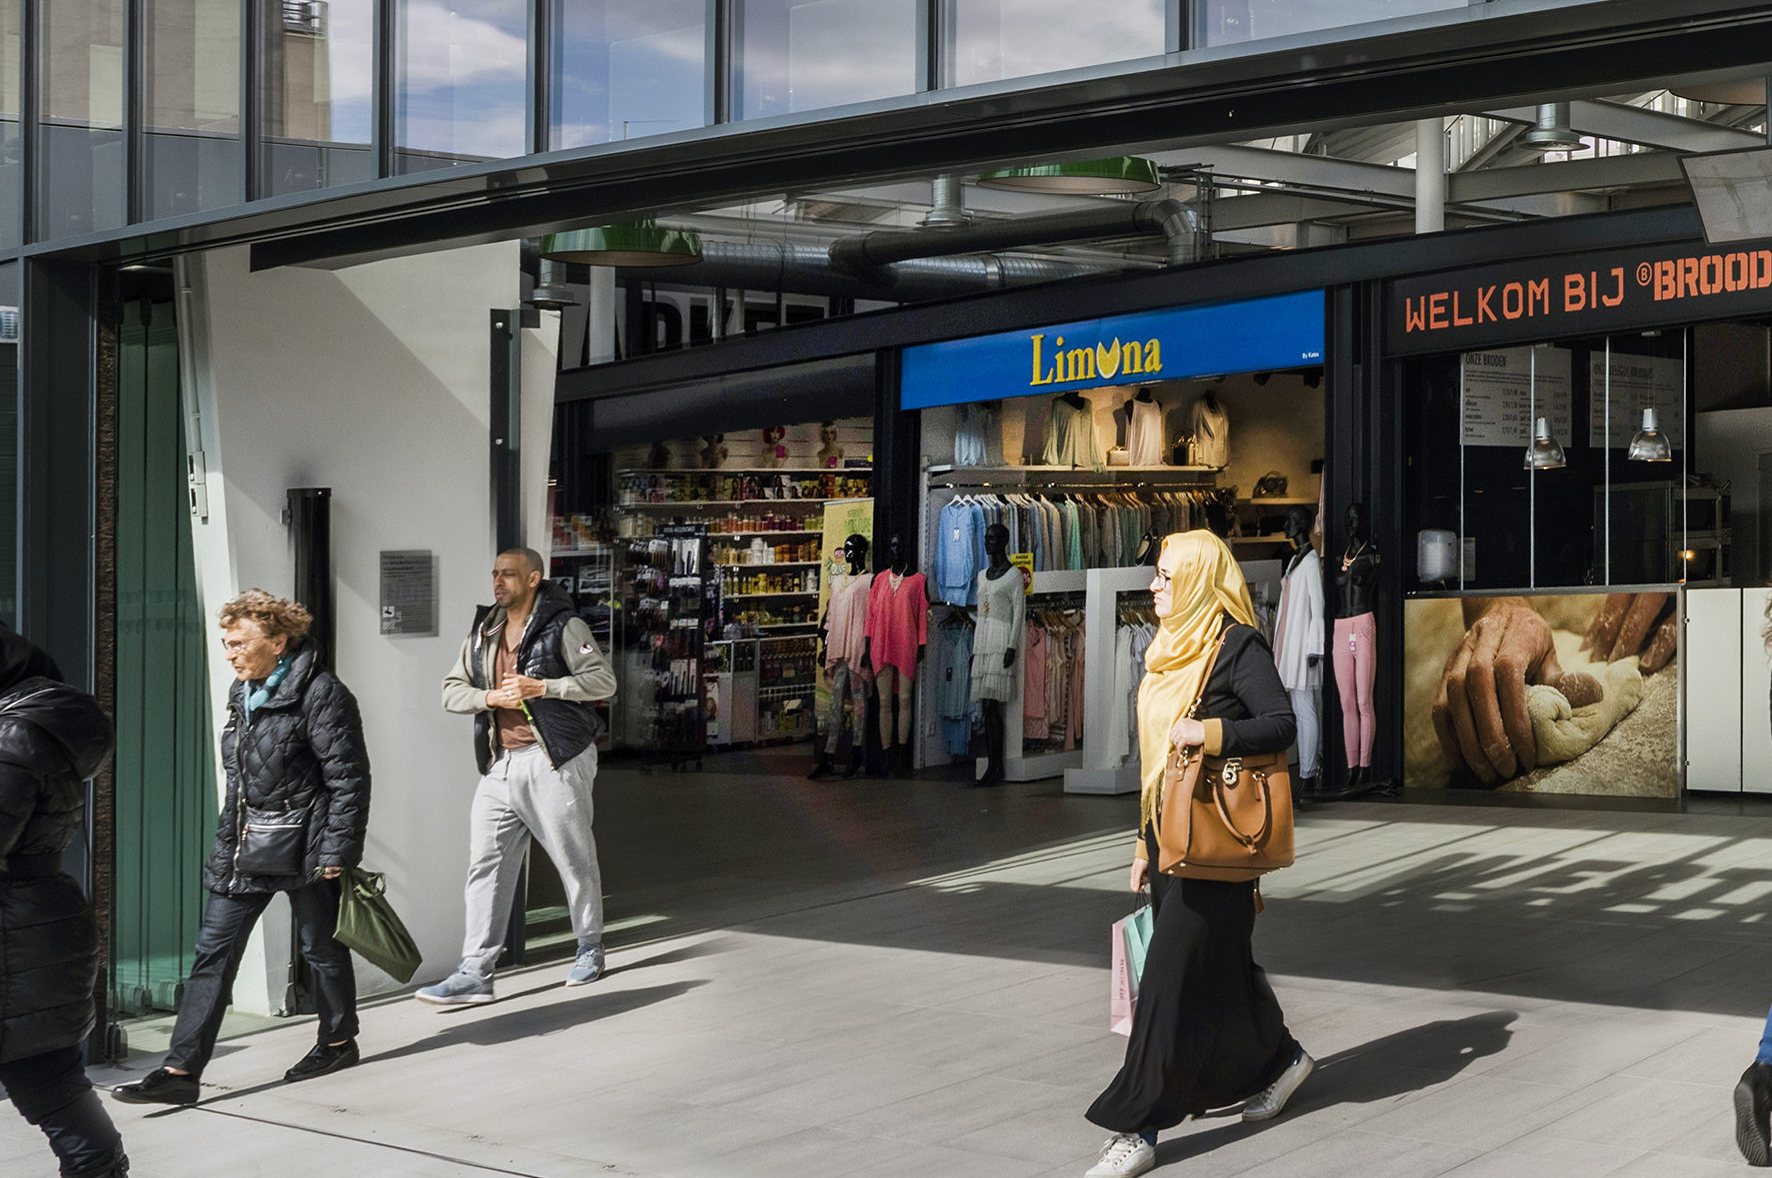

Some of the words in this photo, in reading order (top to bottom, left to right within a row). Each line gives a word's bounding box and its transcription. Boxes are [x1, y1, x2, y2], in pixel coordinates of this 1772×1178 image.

[1405, 278, 1550, 333] WELKOM
[1564, 267, 1625, 312] BIJ
[1653, 250, 1772, 301] BROOD
